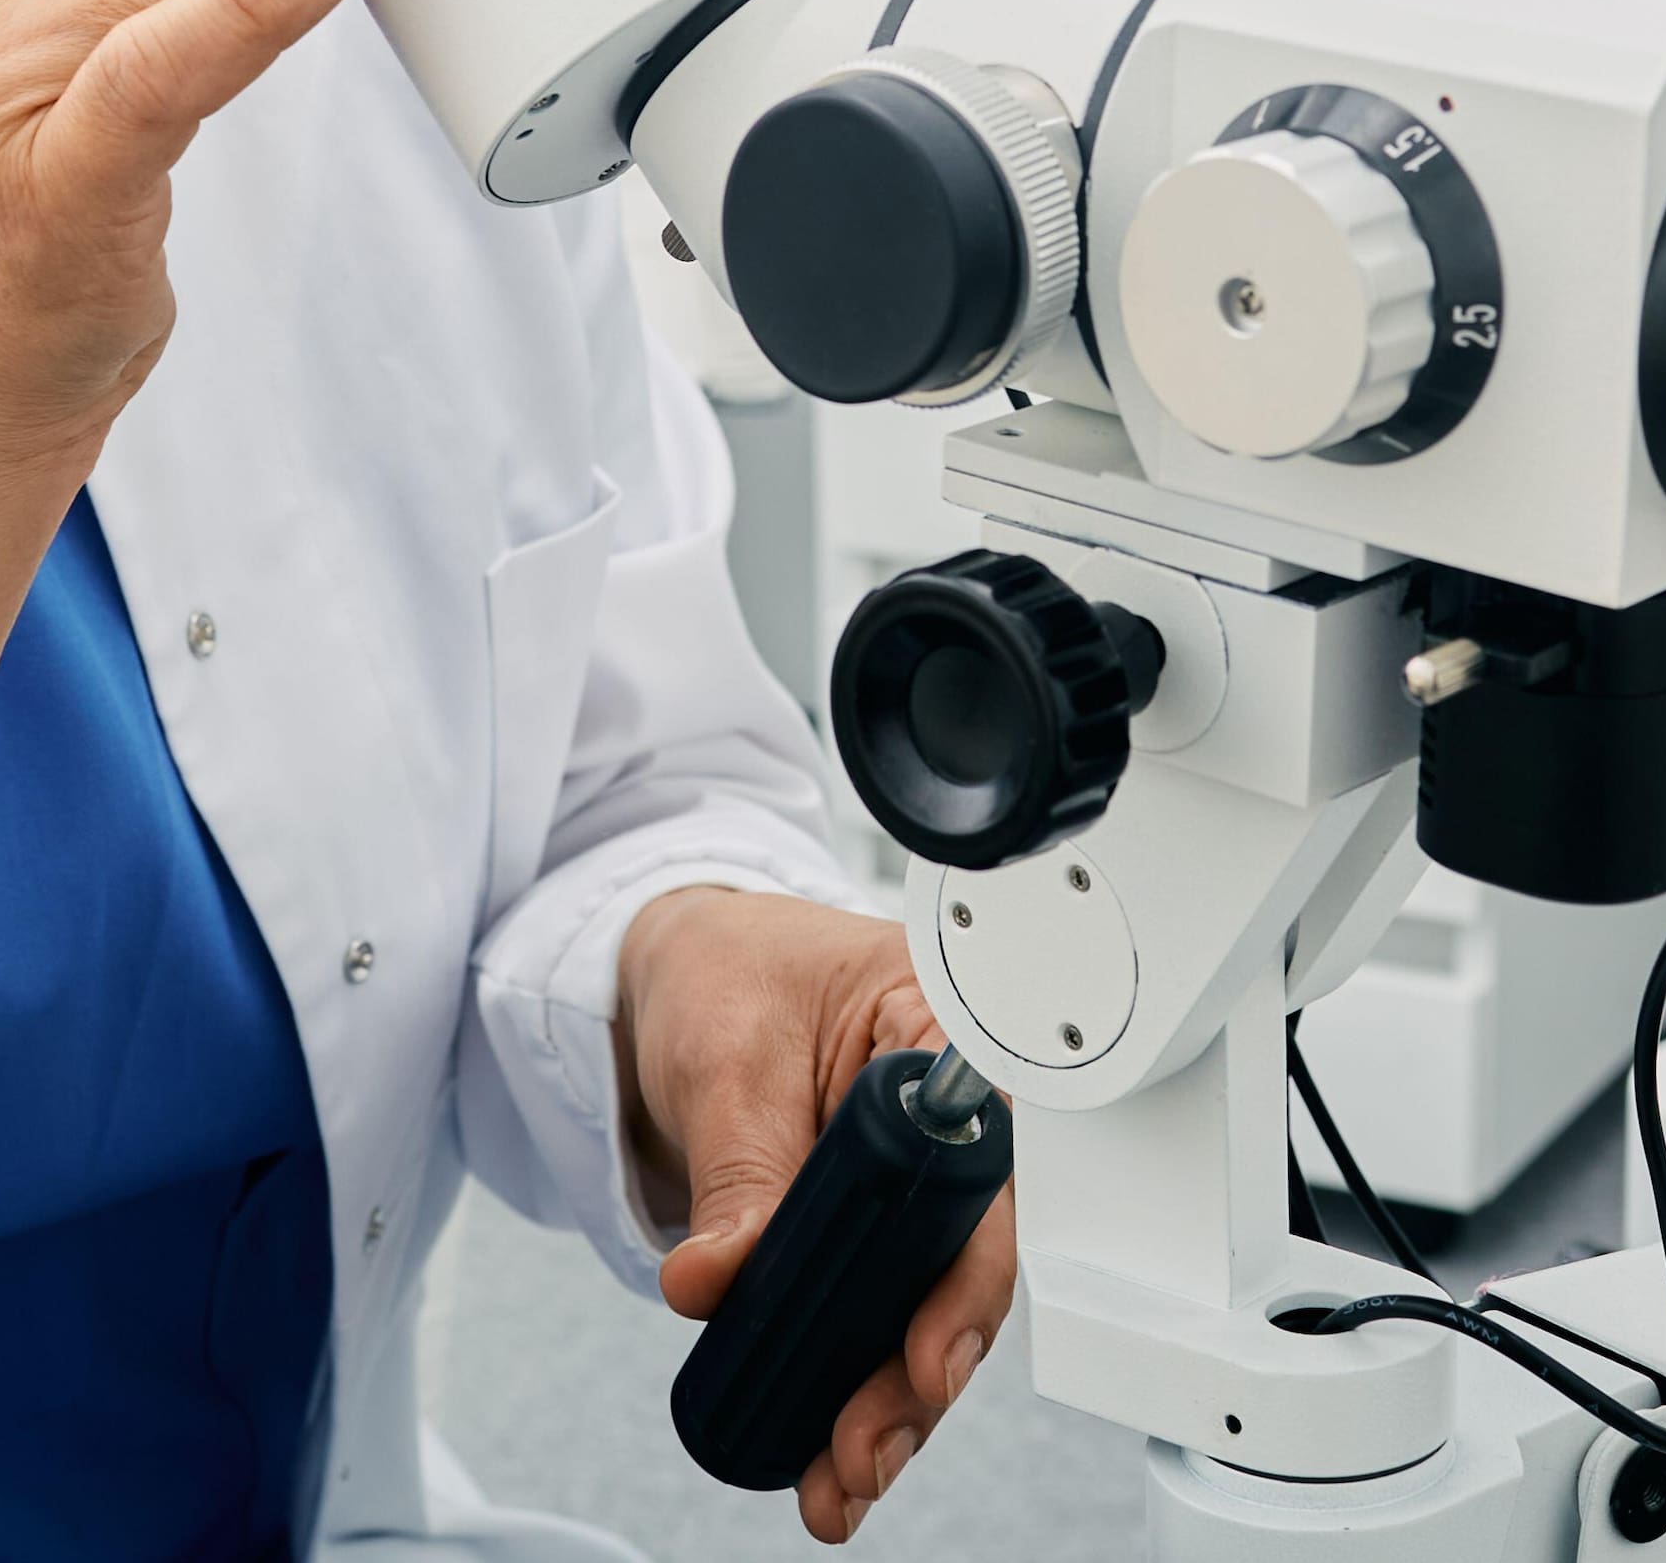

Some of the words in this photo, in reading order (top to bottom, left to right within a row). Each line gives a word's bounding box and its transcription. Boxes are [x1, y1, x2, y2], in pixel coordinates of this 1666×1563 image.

[1383, 125, 1443, 172] 1.5
[1452, 303, 1498, 349] 2.5
[1445, 1311, 1500, 1345] AWM
